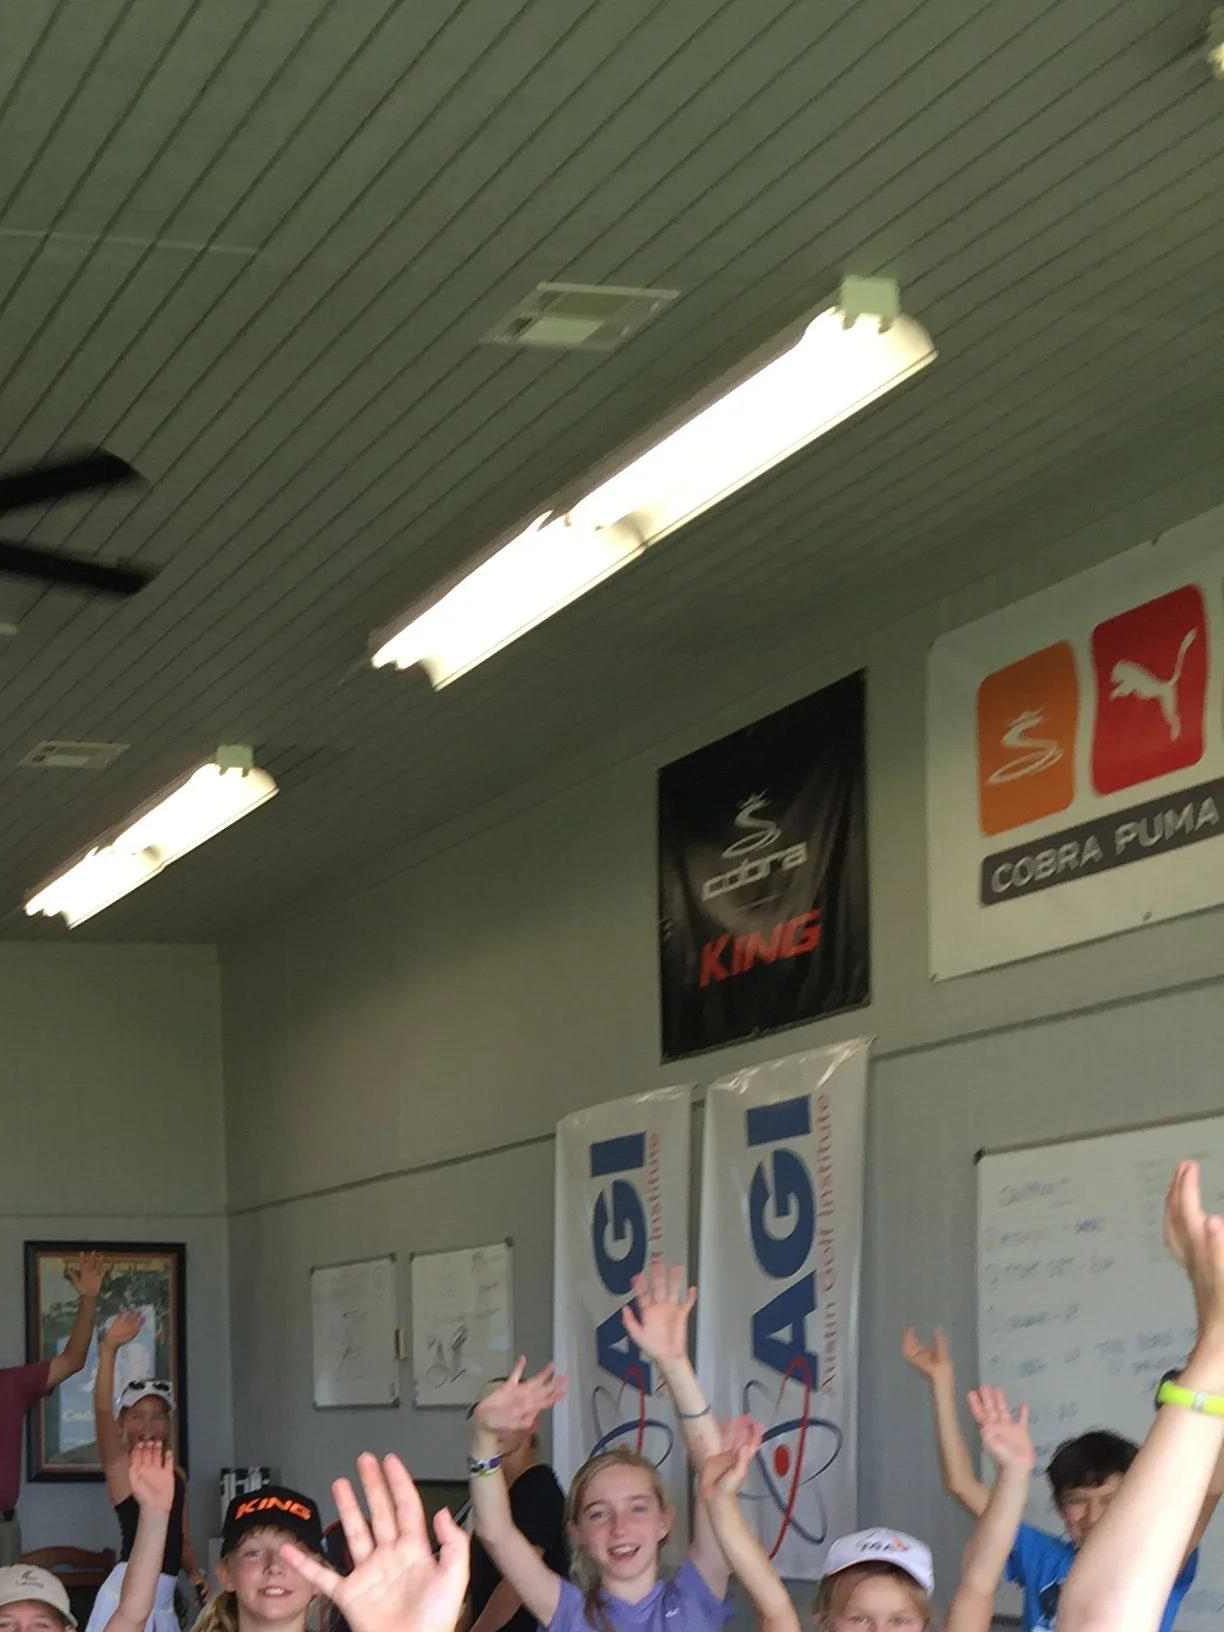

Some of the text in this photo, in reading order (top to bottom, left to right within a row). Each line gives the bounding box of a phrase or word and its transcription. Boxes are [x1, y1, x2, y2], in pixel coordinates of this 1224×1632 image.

[702, 841, 808, 901] cobra
[991, 796, 1220, 893] COBRA PUMA
[699, 908, 822, 988] KING
[815, 1094, 836, 1218] Institute
[590, 1130, 653, 1397] AGI
[746, 1094, 819, 1394] AGI
[234, 1496, 312, 1520] KING
